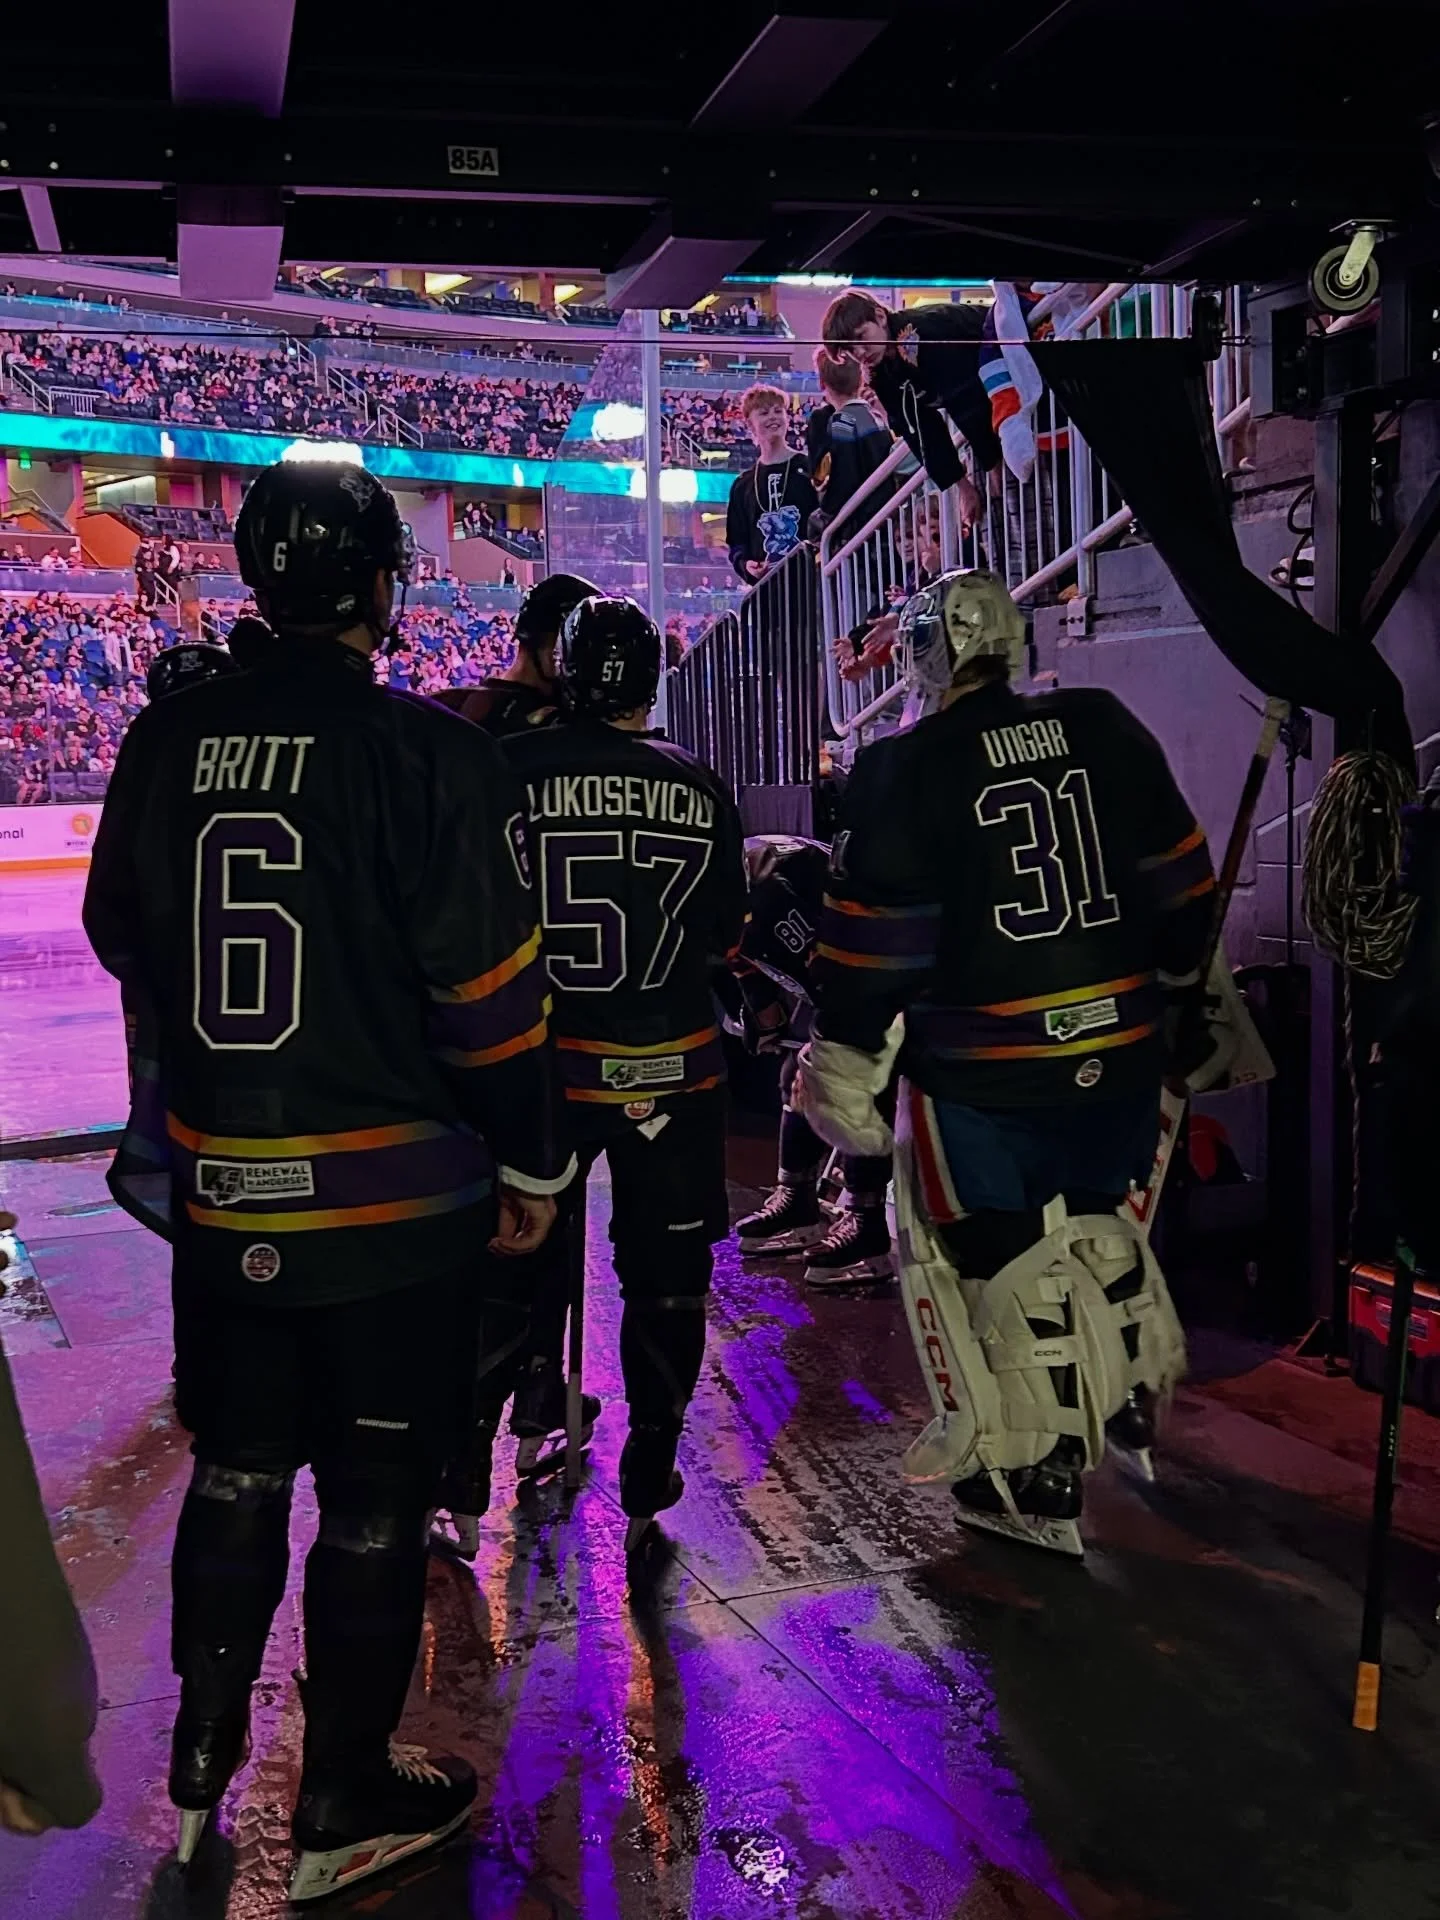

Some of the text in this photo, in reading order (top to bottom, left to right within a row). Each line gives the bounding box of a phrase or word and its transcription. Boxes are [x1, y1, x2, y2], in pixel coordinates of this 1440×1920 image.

[451, 148, 494, 171] 85A
[272, 541, 288, 573] 6
[601, 660, 625, 682] 57
[192, 735, 315, 794] BRITT
[981, 718, 1070, 768] UNGAR
[974, 768, 1121, 942] 31
[193, 812, 303, 1050] 6
[540, 829, 714, 992] 57
[774, 908, 816, 954] 81
[246, 1166, 308, 1177] RENEWAL
[917, 1298, 960, 1411] CCM
[1033, 1349, 1063, 1357] CCM
